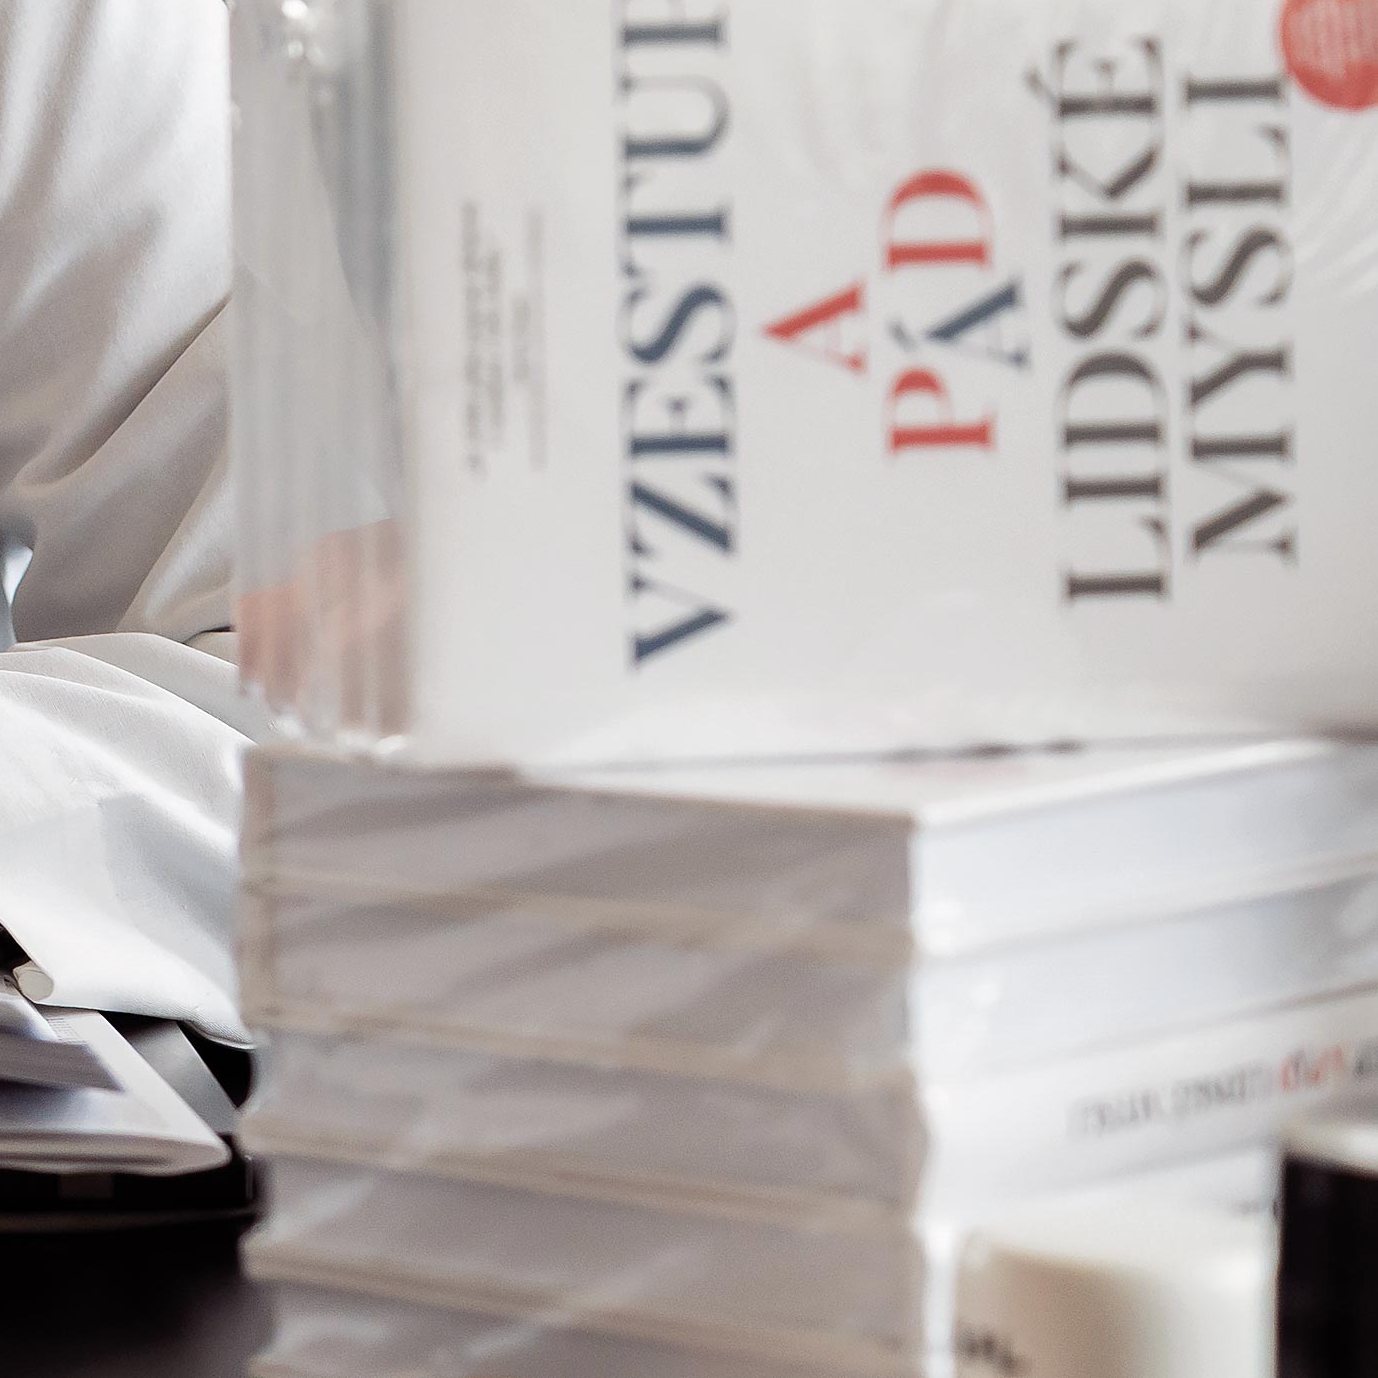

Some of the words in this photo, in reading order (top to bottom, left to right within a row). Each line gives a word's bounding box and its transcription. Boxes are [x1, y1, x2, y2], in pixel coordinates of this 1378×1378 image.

[760, 279, 868, 376] A
[880, 165, 1031, 457] PÁD
[1023, 33, 1172, 606] LIDSKÉ
[1180, 70, 1298, 565] MYSLI
